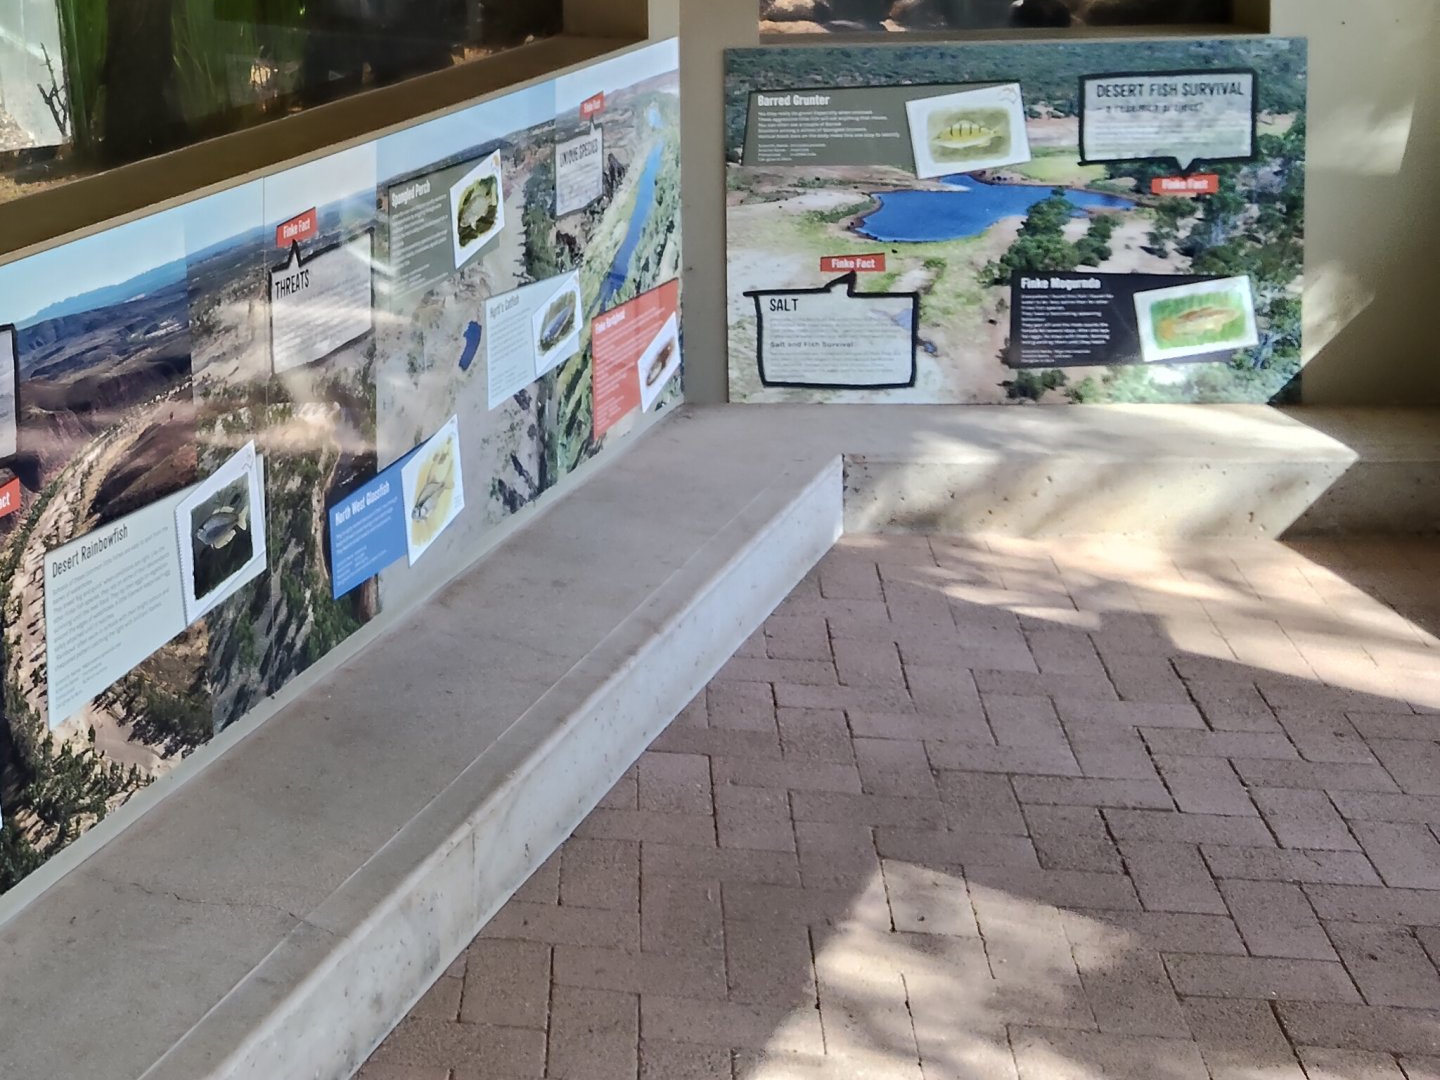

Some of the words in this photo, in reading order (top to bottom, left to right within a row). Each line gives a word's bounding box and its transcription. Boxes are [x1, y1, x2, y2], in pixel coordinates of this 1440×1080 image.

[1096, 83, 1144, 98] DESERT
[1149, 82, 1178, 97] FISH
[1182, 81, 1244, 97] SURVIVAL
[757, 95, 791, 106] Barred
[793, 94, 830, 106] Grunter
[391, 185, 415, 208] Spangled
[415, 180, 431, 197] Perch
[283, 223, 298, 239] Finke
[298, 218, 311, 232] Fact
[831, 259, 854, 269] Finke
[856, 259, 876, 268] Fact
[275, 269, 310, 300] THREATS
[1021, 277, 1049, 289] Finke
[1050, 277, 1101, 291] Mogurnda
[769, 298, 799, 312] SALT
[335, 505, 351, 527] North
[351, 496, 366, 515] West
[52, 549, 79, 578] Desert
[81, 523, 128, 562] Rainbowfish
